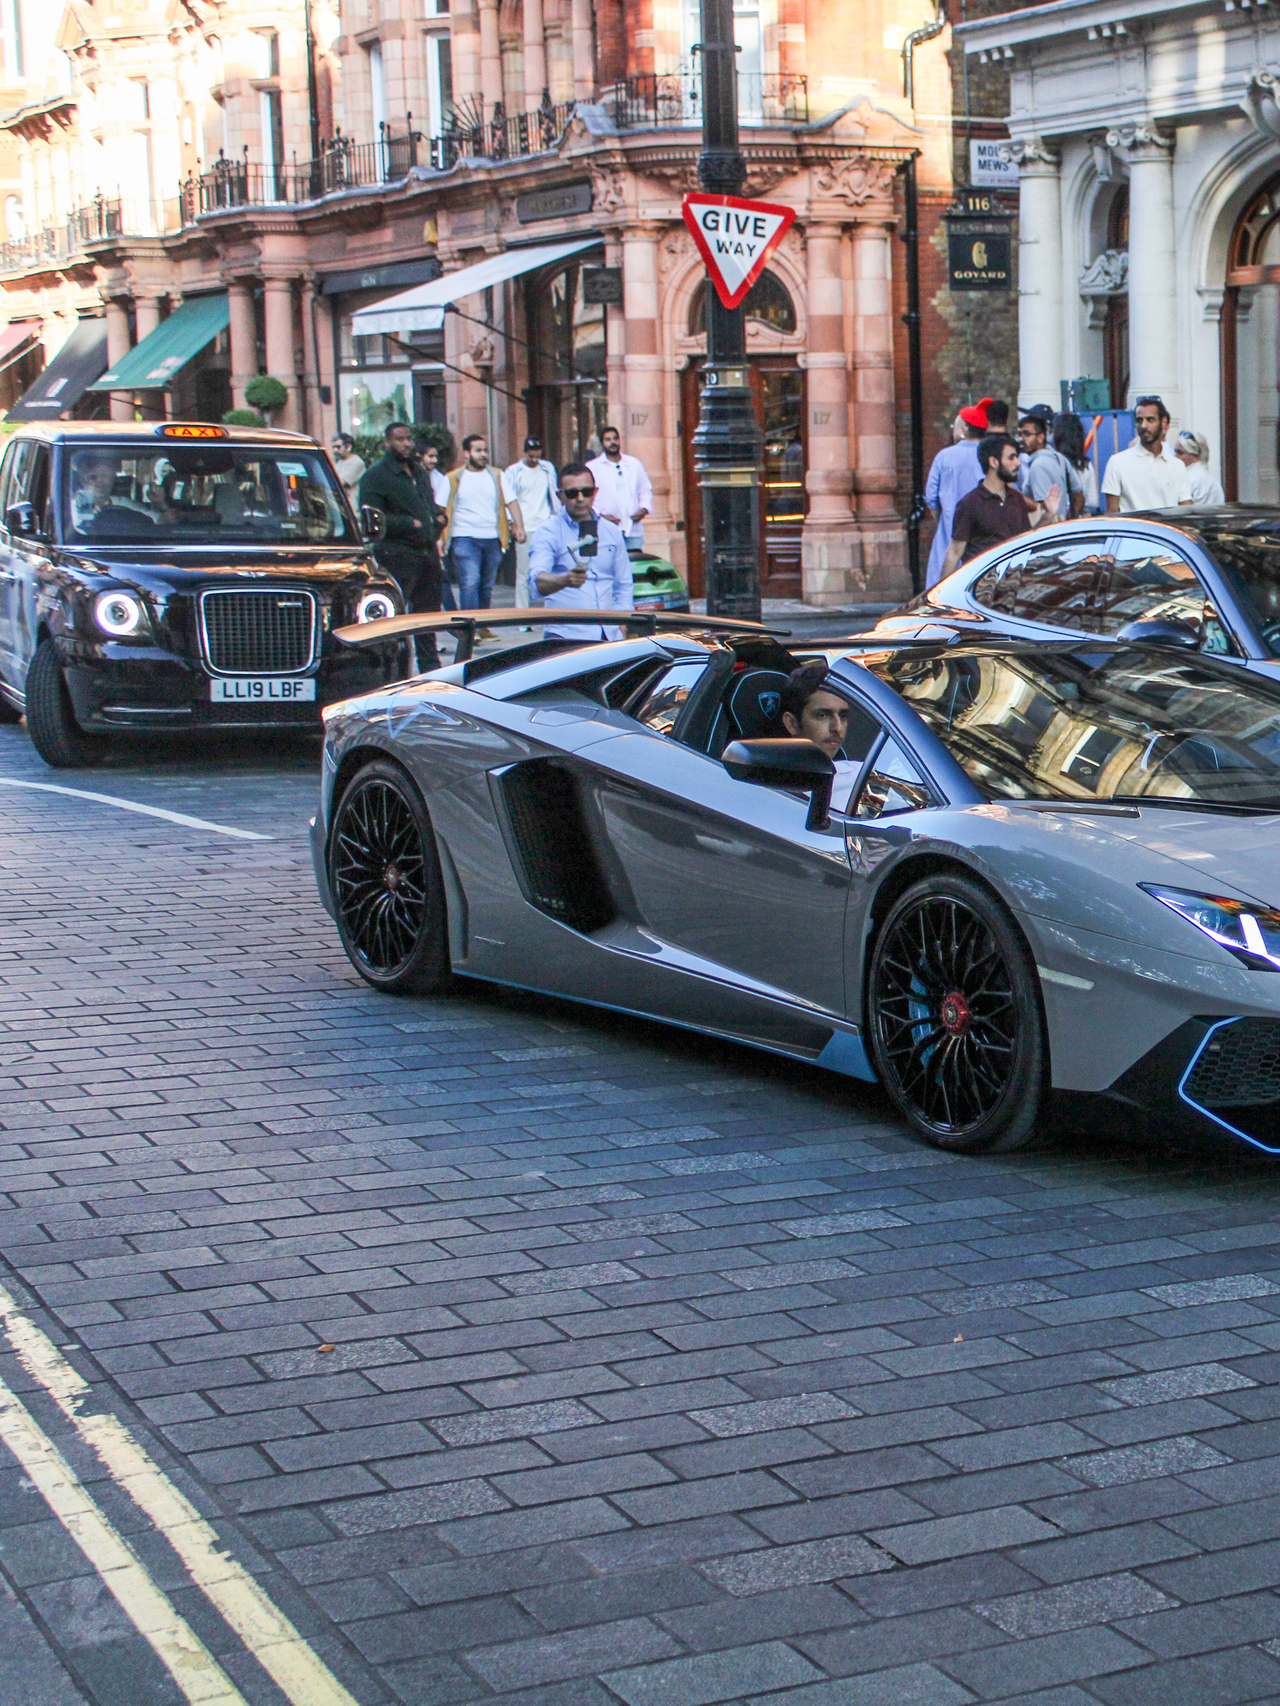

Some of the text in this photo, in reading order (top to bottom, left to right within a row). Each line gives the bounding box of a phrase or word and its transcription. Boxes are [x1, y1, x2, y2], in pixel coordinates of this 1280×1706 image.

[977, 144, 1001, 157] MOU
[977, 158, 1009, 172] MEWS
[968, 197, 990, 211] 116
[702, 209, 767, 239] GIVE
[716, 239, 756, 257] WAY
[953, 270, 1007, 279] GOYARD
[631, 413, 648, 426] 117
[171, 428, 219, 437] TAXI
[223, 681, 304, 698] LL19 LBF
